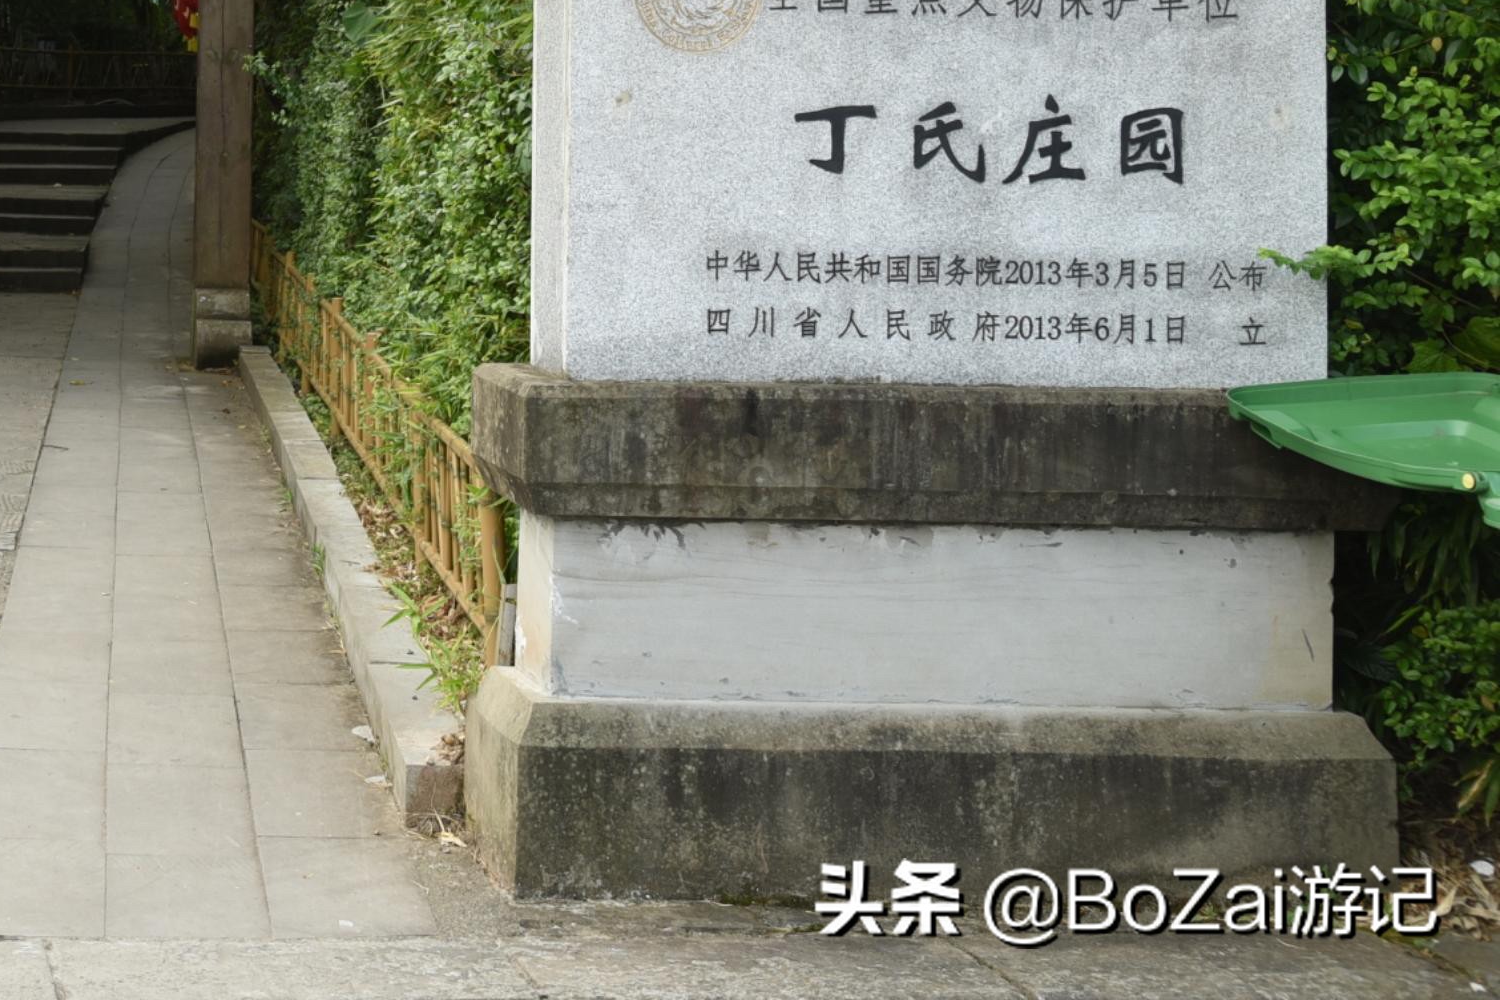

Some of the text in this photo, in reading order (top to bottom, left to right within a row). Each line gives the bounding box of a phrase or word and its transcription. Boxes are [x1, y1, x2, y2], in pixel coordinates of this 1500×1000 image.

[794, 94, 1185, 185] 丁氏庄园
[706, 250, 1267, 291] 中华人民共和国国务院2013年3月5日 公布
[707, 306, 1267, 346] 四川省人民政府2013年6月1日 立
